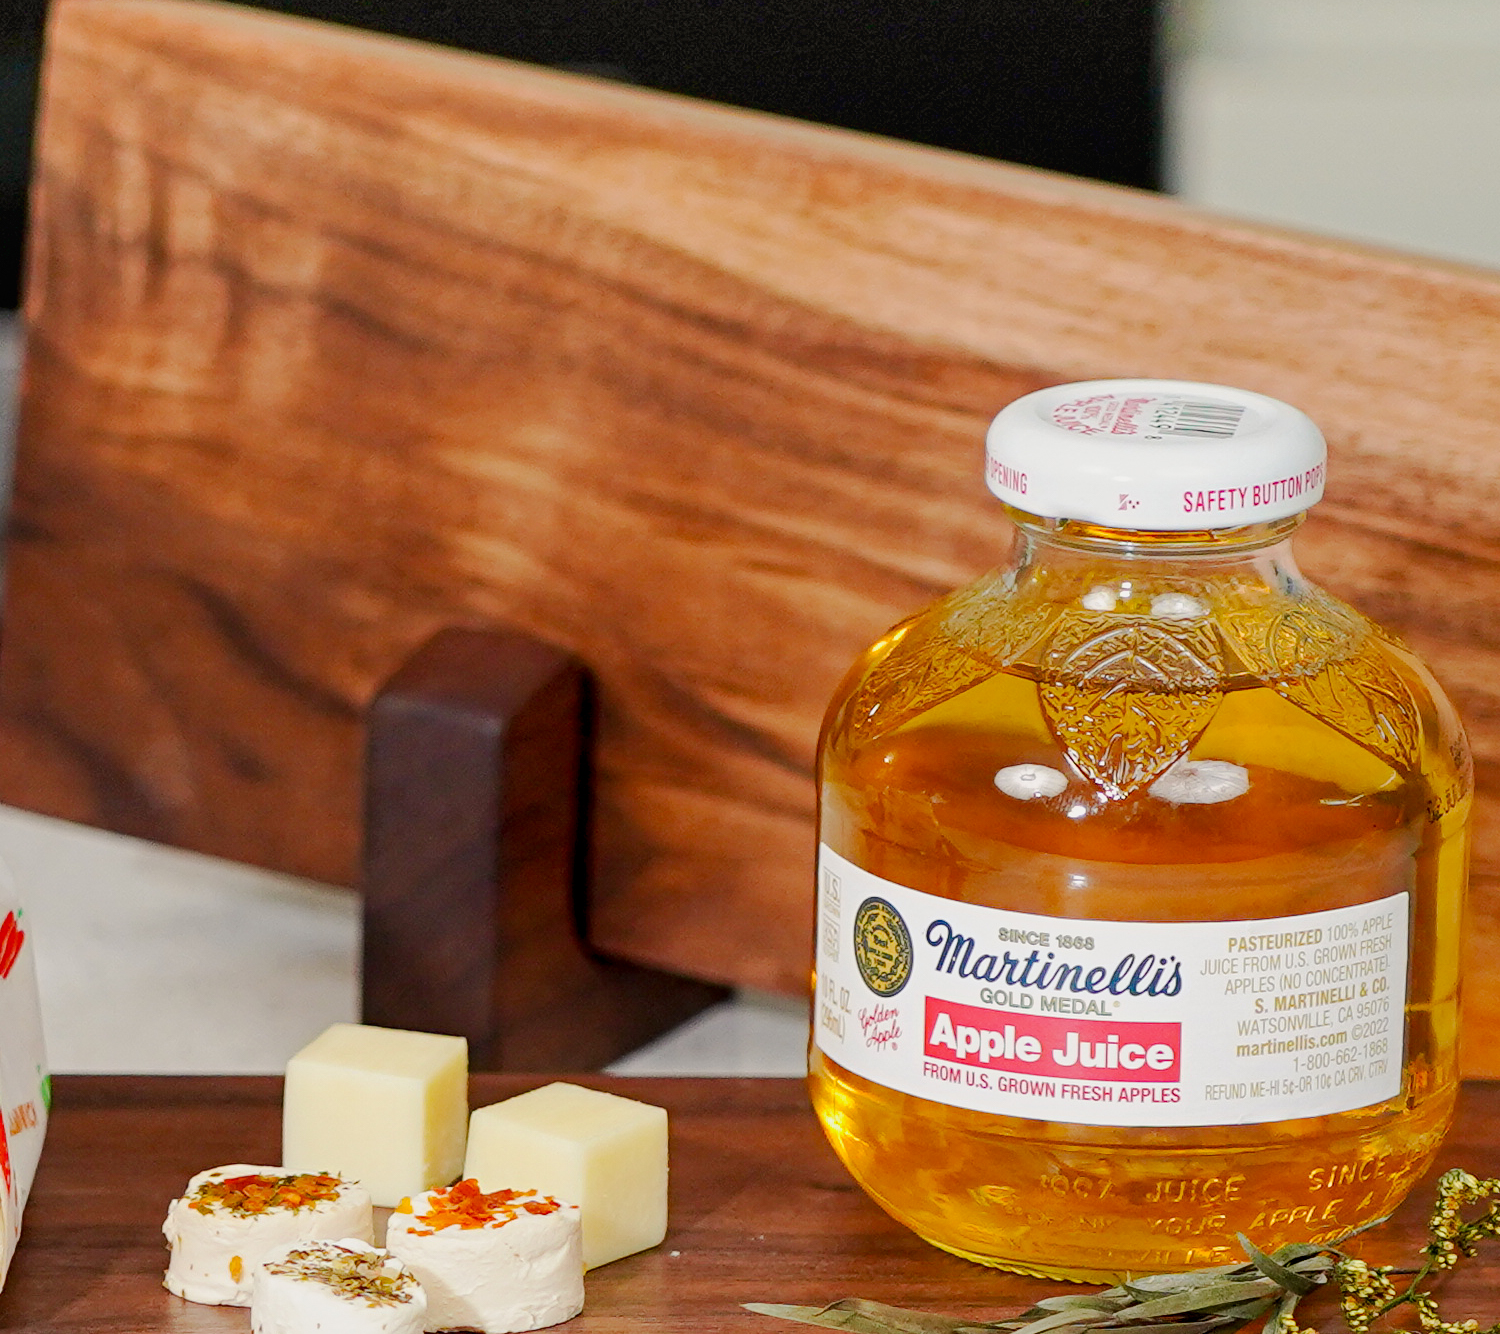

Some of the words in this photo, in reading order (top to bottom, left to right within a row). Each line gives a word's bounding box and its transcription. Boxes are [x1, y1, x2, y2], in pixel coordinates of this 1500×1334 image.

[1183, 486, 1248, 513] SAFETY
[1253, 474, 1302, 506] BUTTON
[998, 927, 1050, 947] SINCE
[1056, 934, 1095, 950] 1868
[1228, 928, 1323, 953] PASTEURIZED
[1327, 922, 1359, 942] 100%
[1362, 913, 1394, 936] APPLE
[926, 919, 1182, 997] Martinelli's
[1200, 958, 1239, 976] JUICE
[1243, 954, 1281, 973] FROM
[1285, 951, 1309, 969] U.S.
[1314, 945, 1357, 966] GROWN
[1360, 933, 1392, 956] FRESH
[980, 987, 1034, 1009] GOLD
[1040, 995, 1112, 1017] MEDAL
[1224, 976, 1275, 996] APPLES
[1279, 973, 1301, 993] (NO
[1254, 998, 1269, 1015] S.
[1274, 984, 1356, 1013] MARTINELLI
[1359, 981, 1368, 998] &
[1372, 976, 1390, 995] CO.
[1237, 1010, 1334, 1037] WATSONVILLE,
[1338, 1005, 1353, 1024] CA
[1357, 996, 1390, 1020] 95076
[929, 1012, 1042, 1064] Apple
[1052, 1031, 1175, 1071] Juice
[1236, 1030, 1348, 1058] martinellis.com
[1293, 1038, 1389, 1072] 1-800-662-1868
[923, 1061, 961, 1085] FROM
[966, 1072, 993, 1091] U.S.
[998, 1076, 1055, 1098] GROWN
[1061, 1084, 1113, 1103] FRESH
[1118, 1087, 1181, 1103] APPLES
[1205, 1082, 1247, 1100] REFUND
[1145, 1174, 1246, 1202] JUICE
[1308, 1153, 1388, 1192] SINCE
[1248, 1198, 1344, 1230] APPLE
